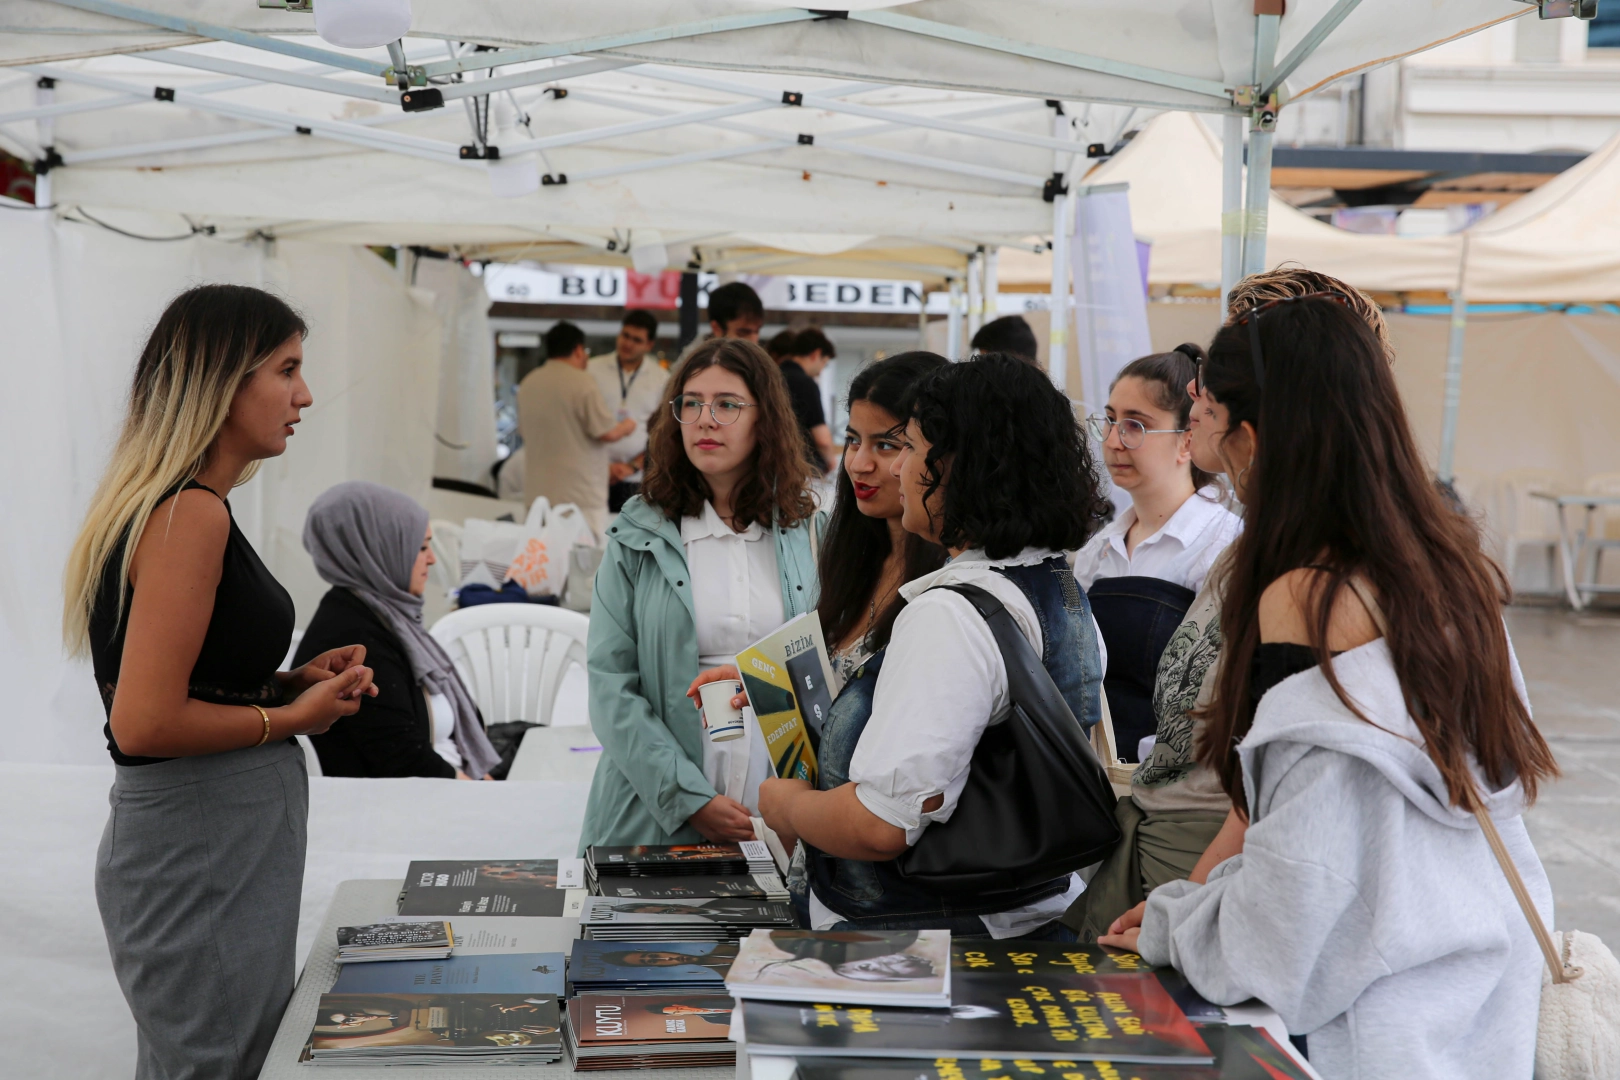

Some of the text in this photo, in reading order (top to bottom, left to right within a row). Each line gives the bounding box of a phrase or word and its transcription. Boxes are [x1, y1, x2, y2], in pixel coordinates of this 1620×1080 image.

[784, 634, 814, 657] BİZİM
[751, 657, 776, 679] GENÇ
[767, 717, 798, 745] EDEBİYAT
[1020, 985, 1056, 1002] ÇOK
[1040, 1005, 1073, 1028] DAHA
[1060, 989, 1095, 1003] BİR
[595, 1005, 622, 1037] KUYTU
[1114, 1016, 1153, 1036] SENİ
